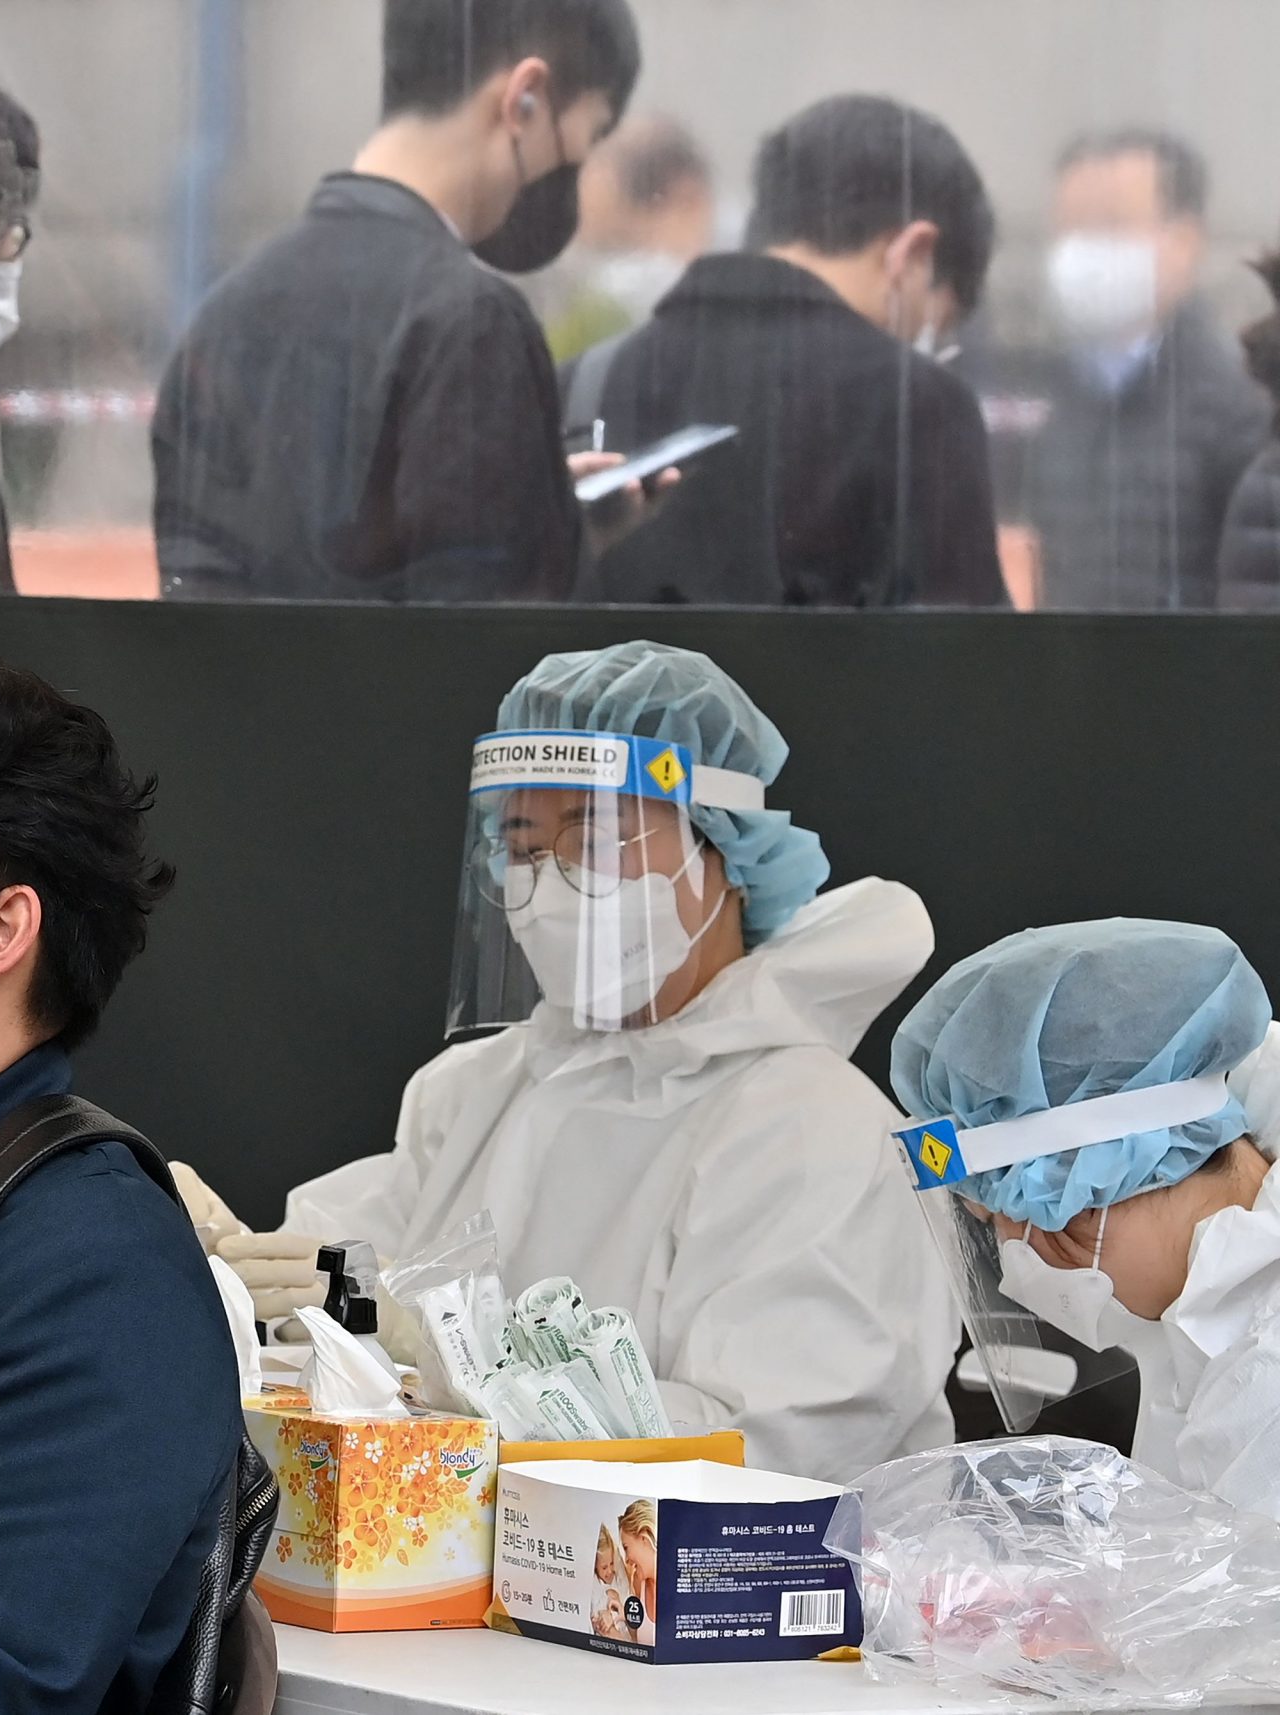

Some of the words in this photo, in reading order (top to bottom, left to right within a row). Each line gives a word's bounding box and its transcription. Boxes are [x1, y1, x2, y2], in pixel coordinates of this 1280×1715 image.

[542, 745, 617, 763] SHIELD
[568, 767, 596, 775] KOREA
[557, 1391, 589, 1431] FLOQSwabs
[440, 1448, 475, 1466] blondy
[504, 1507, 529, 1529] 휴마시스
[721, 1526, 750, 1536] 휴마시스
[752, 1525, 785, 1535] 코비드-19
[795, 1524, 815, 1533] 테스트
[503, 1530, 535, 1552] 코비드-19
[537, 1539, 546, 1558] 홈
[548, 1542, 575, 1561] 테스트
[521, 1557, 545, 1572] COVID-19
[547, 1563, 562, 1576] Home
[564, 1567, 576, 1578] Test
[628, 1601, 639, 1613] 25
